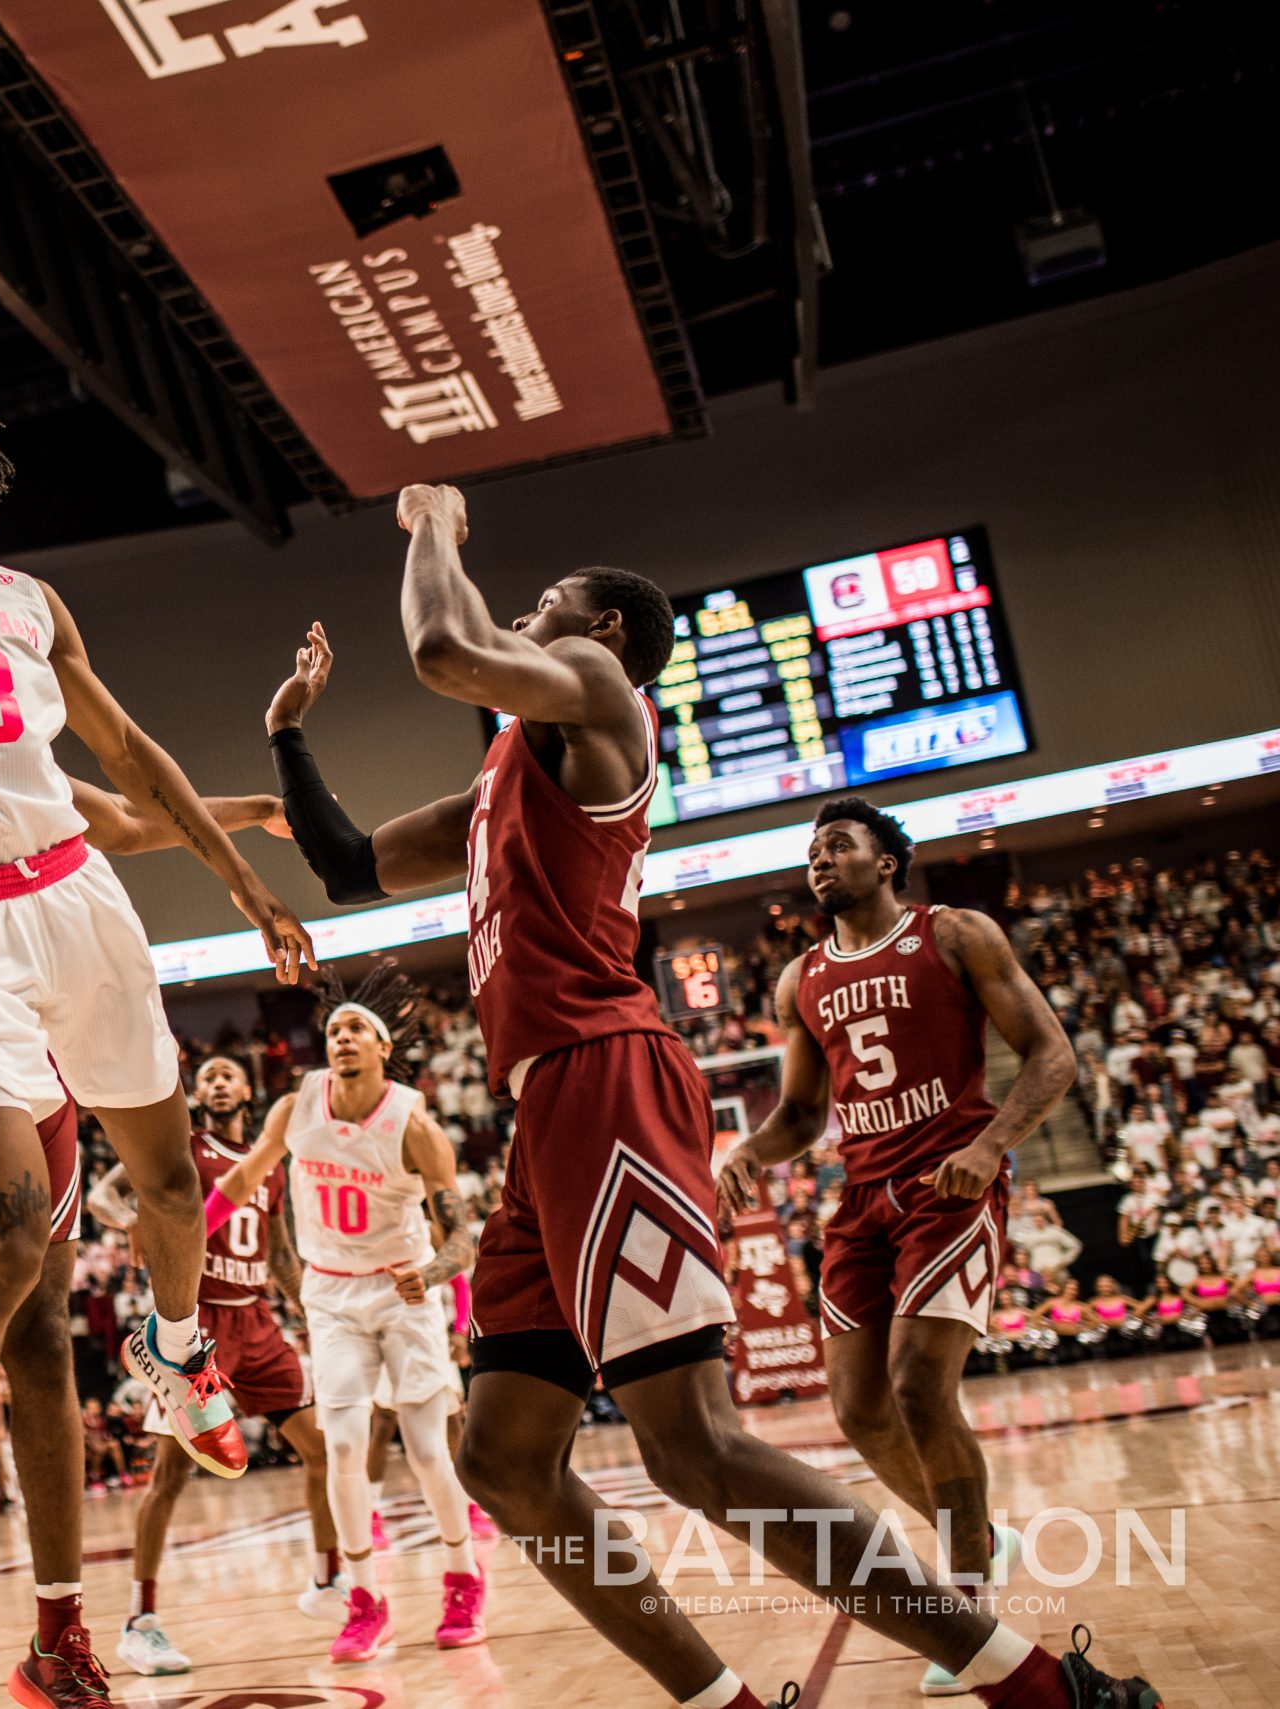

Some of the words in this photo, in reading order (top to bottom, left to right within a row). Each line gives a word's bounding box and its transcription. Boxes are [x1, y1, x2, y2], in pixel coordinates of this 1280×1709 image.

[308, 259, 416, 380] AMERICAN
[362, 247, 462, 373] CAMPUS
[470, 276, 518, 323] love
[481, 311, 546, 374] students
[513, 371, 564, 422] Where
[818, 975, 912, 1033] SOUTH
[845, 1014, 898, 1091] 5
[835, 1077, 951, 1135] CAROLINA
[298, 1159, 346, 1180] TEXAS
[350, 1168, 385, 1188] A&M
[229, 1206, 259, 1257] 0
[316, 1184, 369, 1235] 10
[742, 1323, 813, 1350] WELLS
[746, 1343, 817, 1369] FARGO
